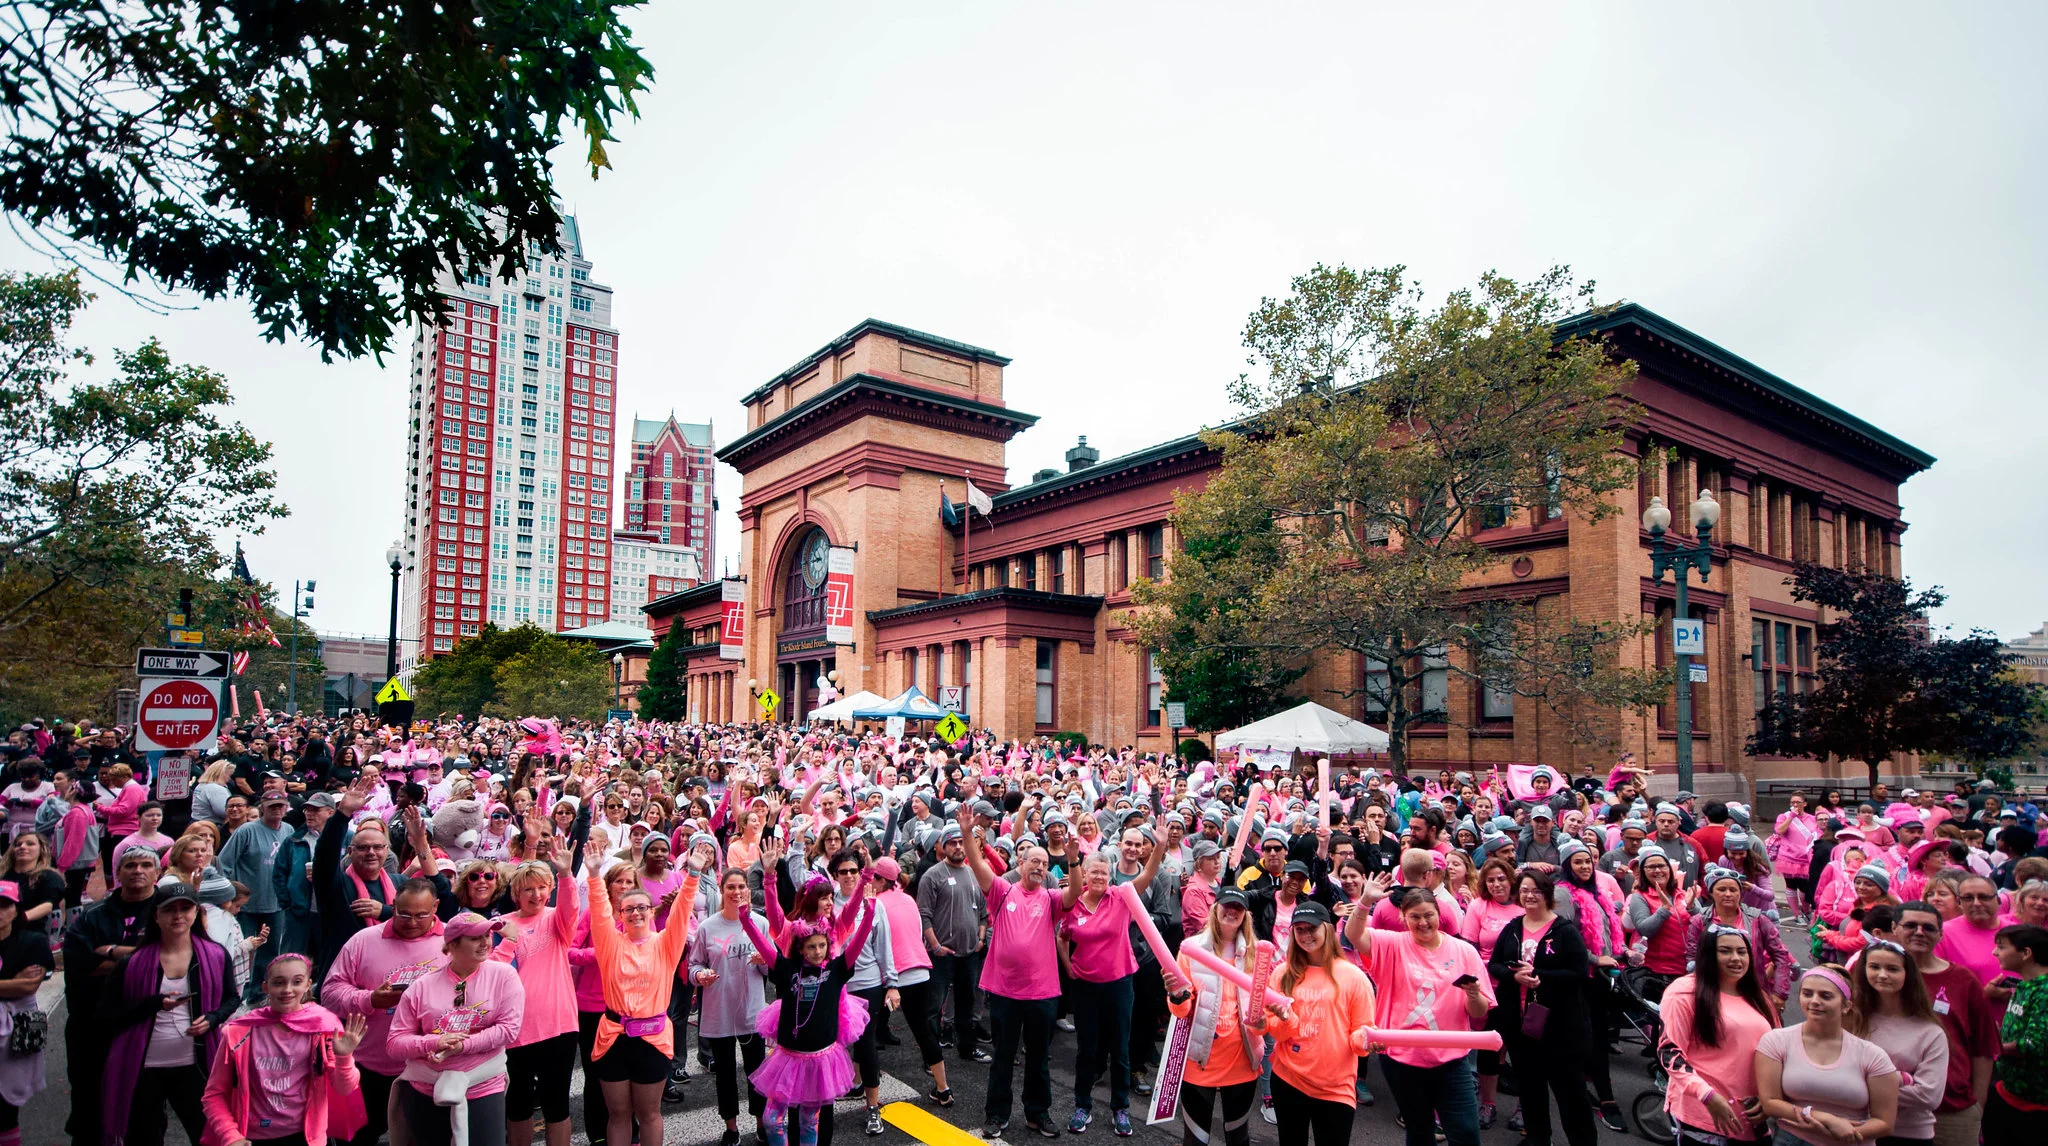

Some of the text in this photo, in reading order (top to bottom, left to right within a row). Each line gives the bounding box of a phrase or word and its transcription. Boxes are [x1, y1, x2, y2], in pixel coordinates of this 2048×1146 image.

[1676, 627, 1689, 647] P
[148, 656, 197, 669] ONE WAY
[154, 693, 209, 705] DO NOT
[156, 724, 200, 735] ENTER
[168, 761, 181, 769] NO
[161, 770, 188, 779] PARKING
[399, 969, 426, 979] HOPE
[1249, 951, 1270, 1023] MAKING STRIDES
[448, 1012, 476, 1022] HOPE
